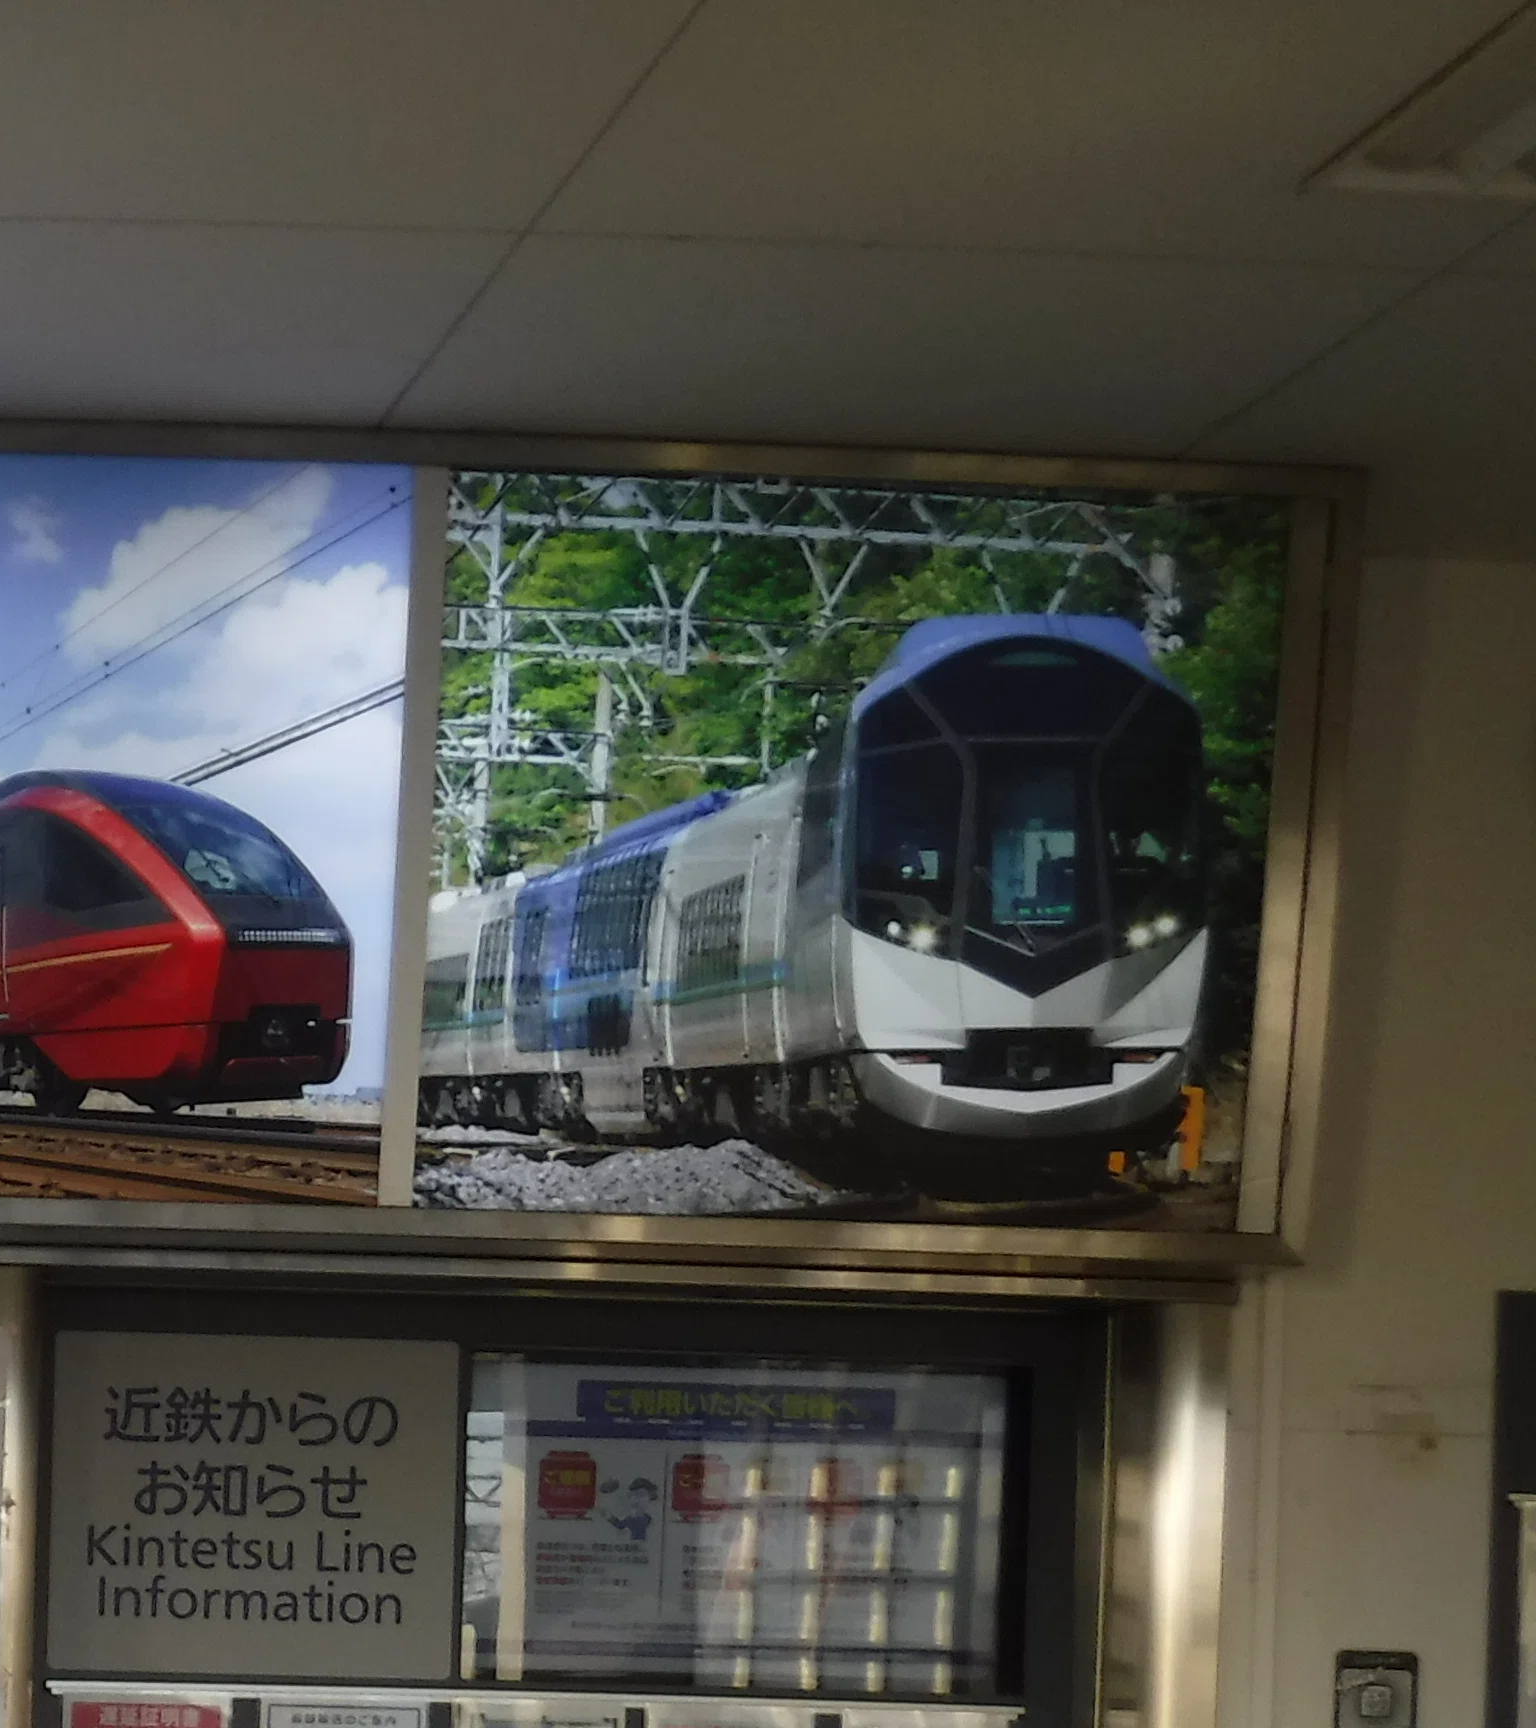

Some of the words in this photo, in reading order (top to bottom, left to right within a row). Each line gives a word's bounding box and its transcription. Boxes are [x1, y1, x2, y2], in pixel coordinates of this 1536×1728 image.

[104, 1386, 398, 1447] 近鉄からの
[134, 1460, 367, 1519] お知らせ
[87, 1524, 294, 1571] Kintetsu
[316, 1530, 417, 1575] Line
[98, 1575, 402, 1625] Information
